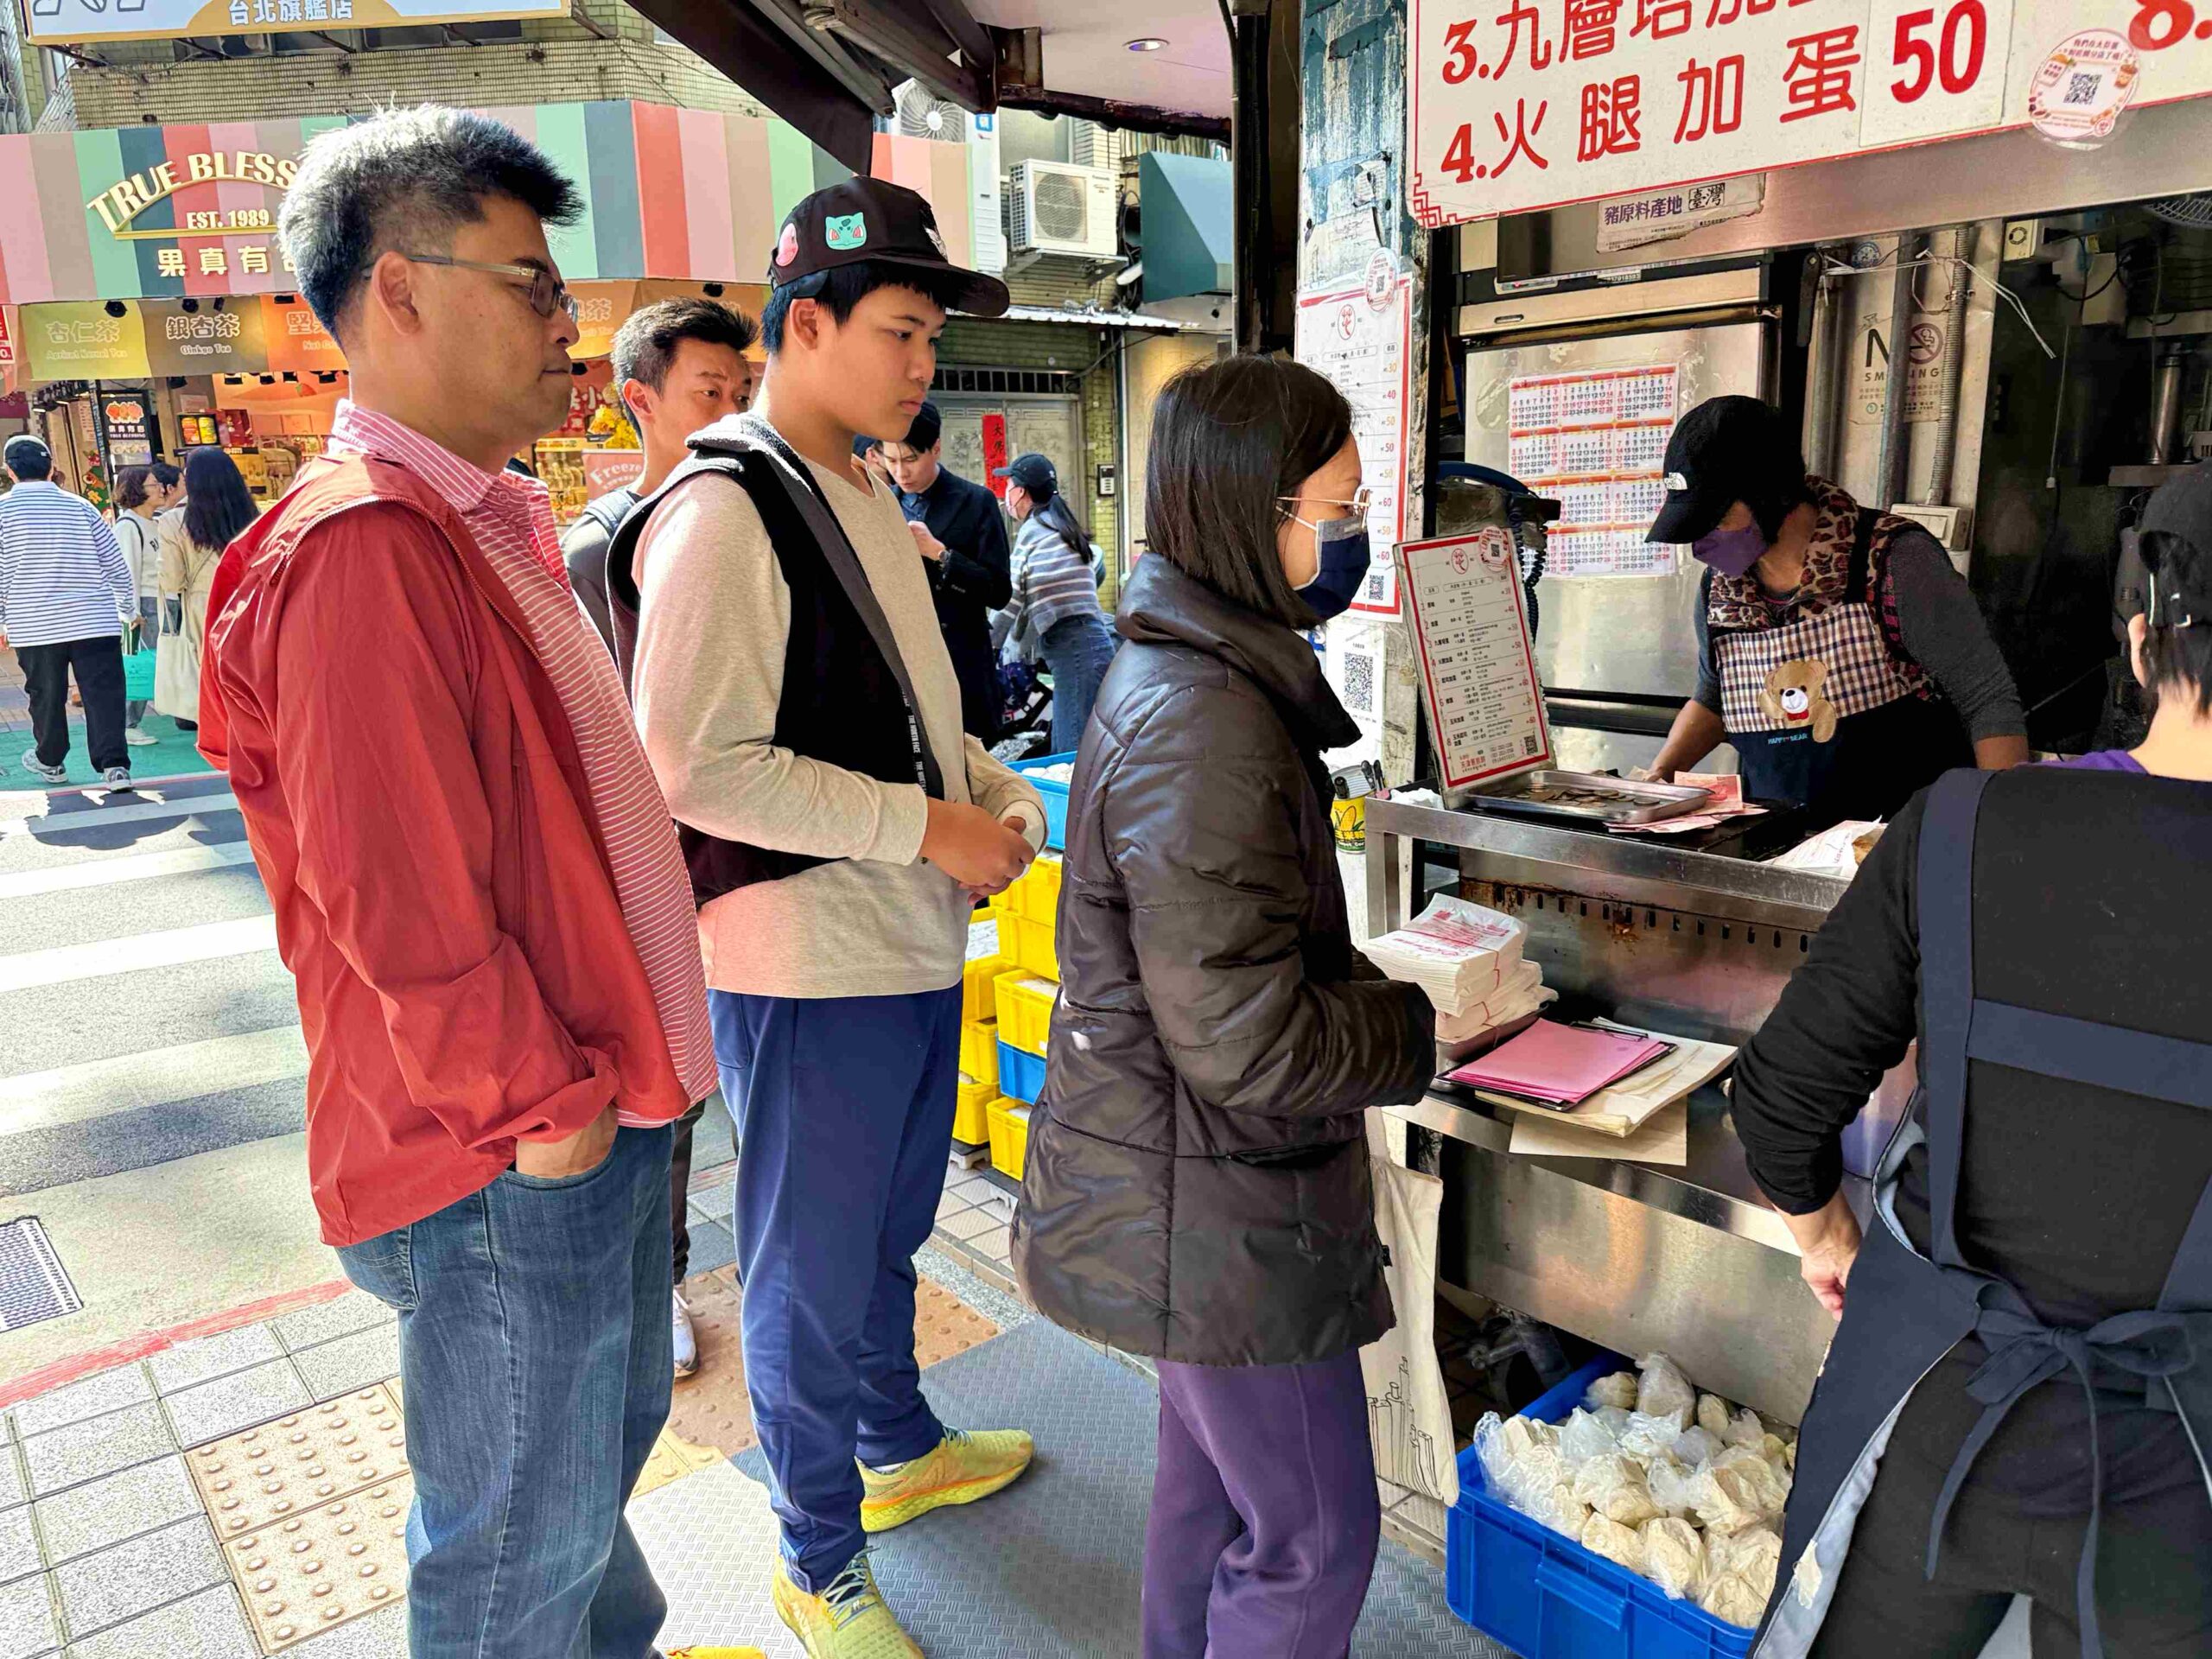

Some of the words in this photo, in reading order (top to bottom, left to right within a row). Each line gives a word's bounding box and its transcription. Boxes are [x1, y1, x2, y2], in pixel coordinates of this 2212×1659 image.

[1891, 0, 1986, 104] 50
[86, 161, 181, 233] TRUE
[188, 150, 298, 190] BLESS
[1605, 195, 1683, 226] 豬原料產地
[1691, 183, 1725, 209] 臺灣
[187, 211, 224, 229] EST.
[228, 209, 270, 227] 1989
[47, 320, 121, 344] 杏仁茶
[166, 315, 240, 340] 銀杏茶
[181, 345, 213, 355] Ginkgo
[214, 343, 232, 353] Tea
[1387, 390, 1396, 400] 40
[1385, 442, 1395, 453] 50
[1381, 551, 1389, 560] 60
